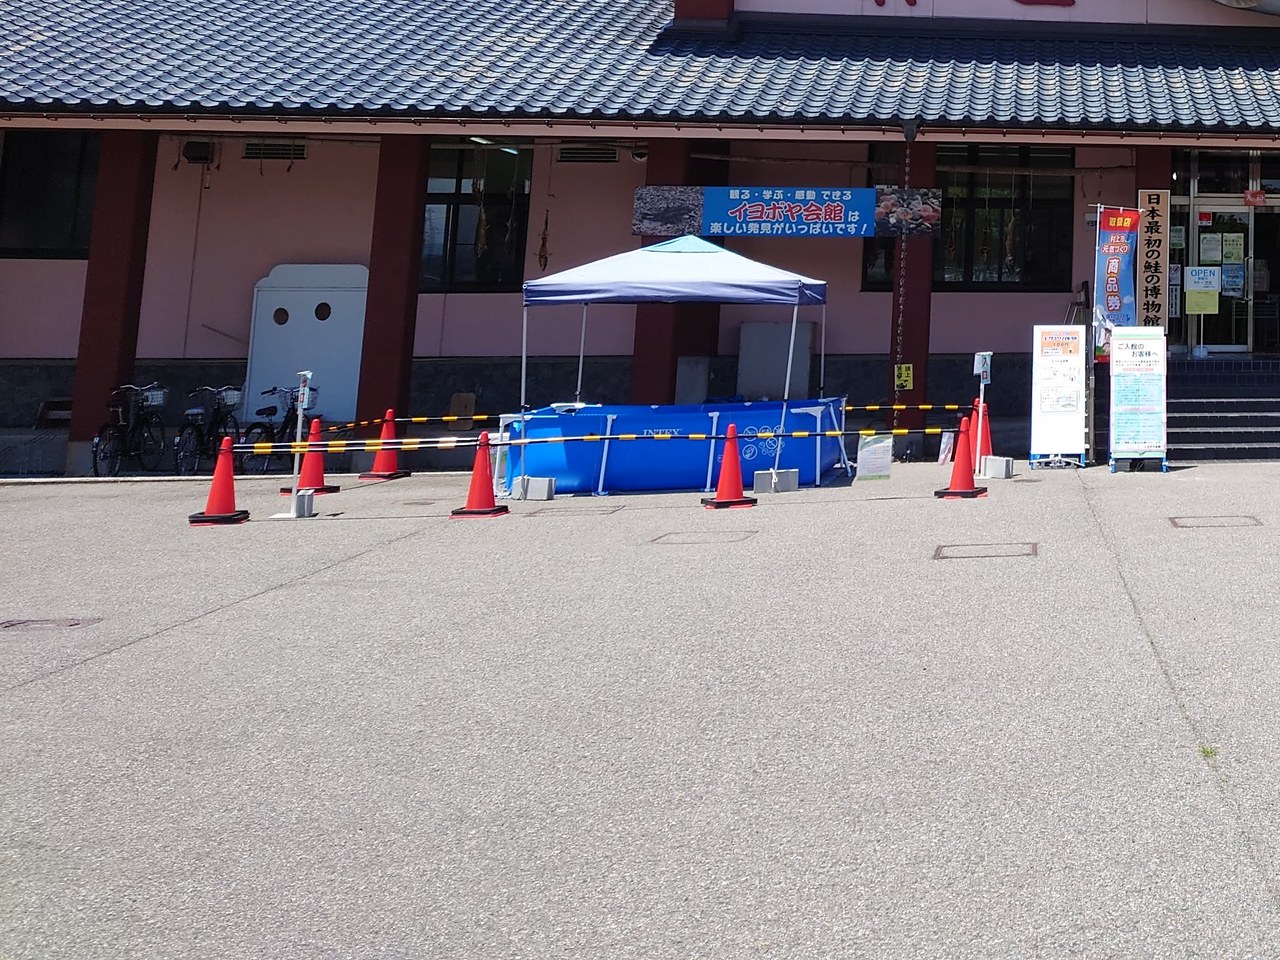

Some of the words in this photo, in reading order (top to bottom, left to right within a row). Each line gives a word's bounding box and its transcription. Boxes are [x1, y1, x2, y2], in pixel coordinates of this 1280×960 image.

[821, 190, 852, 200] できる
[1142, 193, 1164, 327] 日本最初の鮭の博物館
[1190, 269, 1216, 277] OPEN
[1106, 257, 1121, 311] 商品券
